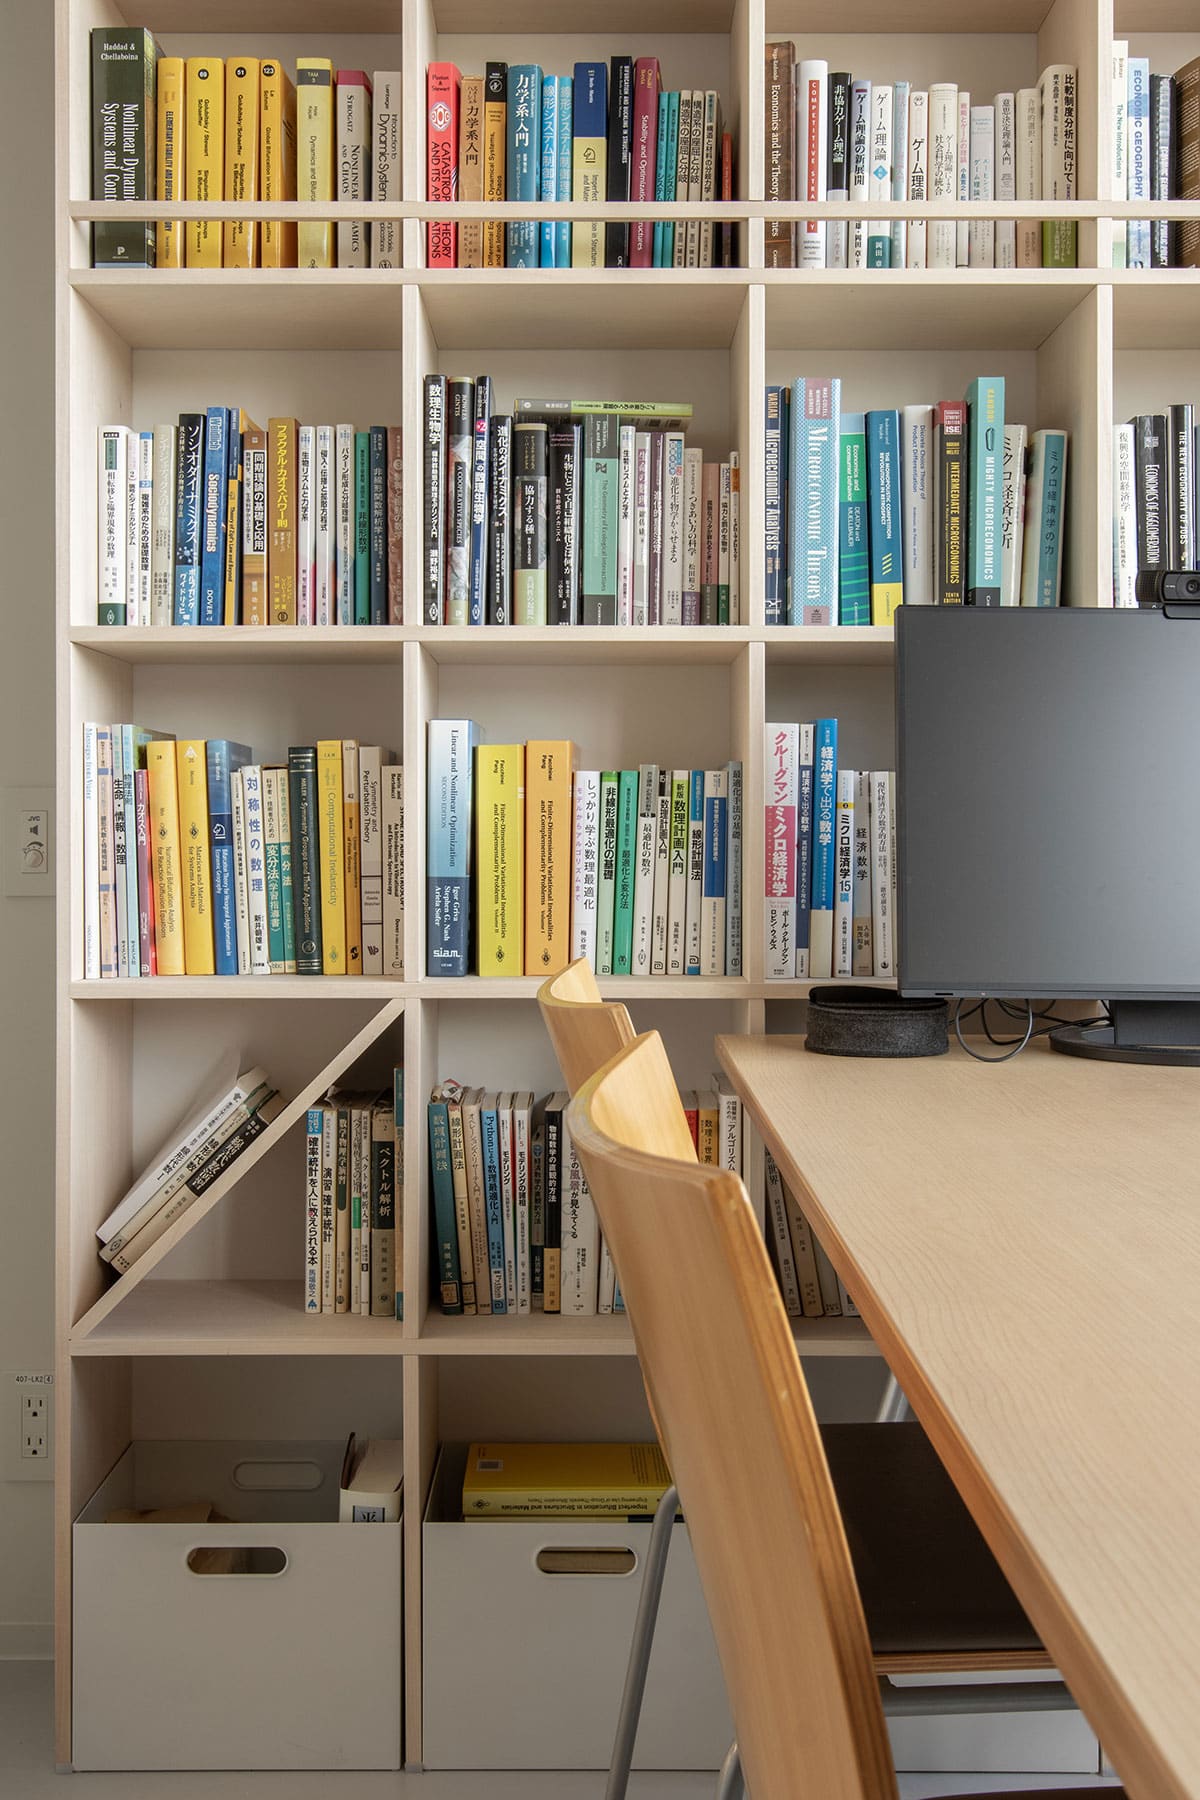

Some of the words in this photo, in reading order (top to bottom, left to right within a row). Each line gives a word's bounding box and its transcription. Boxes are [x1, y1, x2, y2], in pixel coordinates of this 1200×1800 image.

[100, 52, 139, 61] Chellaboina
[103, 43, 128, 51] Haddad
[101, 103, 119, 147] Systems
[346, 94, 354, 132] STROGATZ
[515, 74, 530, 148] 力学系入門
[770, 84, 781, 131] Economics
[832, 85, 846, 163] 非協力ゲーム理論
[1134, 70, 1142, 128] ECONOMIC
[122, 104, 139, 154] Nonlinear
[166, 111, 174, 142] ELEMENTARY
[308, 136, 317, 166] Dynamics
[378, 114, 390, 162] Dynamic
[390, 113, 398, 154] Introduction
[465, 106, 479, 166] 力学系入門
[638, 114, 648, 142] Stability
[770, 132, 782, 150] and
[854, 94, 866, 186] ゲーム理論の新展開
[874, 93, 888, 161] ゲーム理論
[1063, 73, 1075, 183] 比較制度分析に向けて
[1116, 132, 1124, 170] Introduction
[104, 150, 120, 170] and
[166, 143, 174, 168] STABILITY
[342, 160, 351, 194] CHAOS
[352, 144, 360, 200] NONLINEAR
[431, 142, 440, 165] AND
[431, 166, 440, 183] ITS
[1134, 130, 1144, 197] GEOGRAPHY
[769, 166, 782, 195] Theory
[428, 384, 442, 444] 数理生物学
[768, 392, 778, 419] VARIAN
[852, 444, 860, 476] Economics
[1178, 430, 1188, 446] THE
[1178, 447, 1188, 463] NEW
[185, 425, 200, 544] ソシオダイナミクス
[301, 451, 310, 521] 生物リズムと力学系
[497, 425, 508, 517] 進化のダイナミクス
[622, 450, 630, 520] 生物リズムと力学系
[766, 429, 781, 506] Microeconomic
[808, 425, 828, 542] MICROECONOMIC
[918, 471, 926, 492] Theory
[950, 462, 961, 515] INTERMEDIATE
[985, 456, 994, 492] MIGHTY
[1002, 436, 1014, 549] ミクロ経済分析
[1119, 432, 1130, 512] 復興の空間経済学
[1144, 464, 1160, 502] ECONOMICS
[1178, 466, 1188, 511] GEOGRAPHY
[106, 471, 116, 559] 相転移と臨界現象の数理
[206, 473, 220, 552] Sociodynamics
[524, 484, 535, 534] 協力する種
[564, 454, 575, 574] 生物にとって自己組織化とは何か
[670, 477, 680, 564] 進化生物学からせまる
[688, 496, 698, 556] つきあい方の科学
[1044, 450, 1060, 556] ミクロ経済学の力
[141, 493, 150, 572] 複雑系のための基礎数理
[358, 511, 368, 554] 非線形数学
[456, 518, 464, 544] SPECIES
[764, 508, 781, 551] Analysis
[950, 516, 961, 584] MICROECONOMICS
[984, 496, 994, 580] MICROECONOMICS
[1145, 512, 1160, 564] AGGLOMERATION
[1179, 525, 1188, 544] JOBS
[808, 546, 828, 600] THEORY
[450, 729, 458, 756] Linear
[450, 757, 458, 772] and
[773, 731, 788, 804] クルーグマン
[266, 778, 274, 840] 科学者・技術者のための
[370, 780, 378, 816] Symmetry
[450, 774, 458, 813] Nonlinear
[676, 783, 685, 799] 新版
[800, 770, 811, 833] 経済学で出る数学
[818, 746, 834, 846] 経済学で出る数学
[114, 778, 126, 865] 生命・情報・数理
[247, 776, 263, 892] 対称性の数理
[326, 792, 337, 857] Computational
[363, 818, 371, 844] Theory
[449, 815, 458, 867] Optimization
[546, 800, 554, 864] Finite-Dimensional
[584, 779, 596, 910] しっかり学ぶ数理最適化
[603, 787, 617, 880] 非線形最適化の基礎
[658, 799, 670, 859] 数理計画入門
[672, 800, 686, 875] 数理計画入門
[188, 855, 196, 876] Systems
[641, 823, 652, 877] 最適化の数学
[690, 829, 703, 881] 線形計画法
[772, 806, 788, 897] ミクロ経済学
[838, 814, 851, 902] ミクロ経済学15講
[856, 828, 868, 882] 経済数学
[189, 877, 197, 908] Analysis
[328, 859, 338, 906] Inelasticity
[434, 886, 442, 907] Ariela
[442, 886, 451, 912] Stephen
[620, 850, 632, 909] 最適化と変分法
[302, 892, 312, 933] Applications
[434, 908, 442, 926] Sofer
[546, 902, 554, 942] Inequalities
[186, 1137, 220, 1173] 線形代数
[432, 1114, 448, 1171] 数理計画法
[451, 1117, 464, 1170] 線形計画法
[502, 1150, 511, 1186] モデリング
[548, 1124, 558, 1204] 物理数学の直観的方法
[704, 1120, 713, 1164] 数理は世界
[322, 1167, 333, 1192] 演習
[378, 1146, 392, 1218] ベクトル解析
[486, 1116, 500, 1225] Pythonによる数理最適化入門
[307, 1136, 319, 1266] 確率統計を人に教えられる本
[322, 1194, 333, 1243] 確率統計
